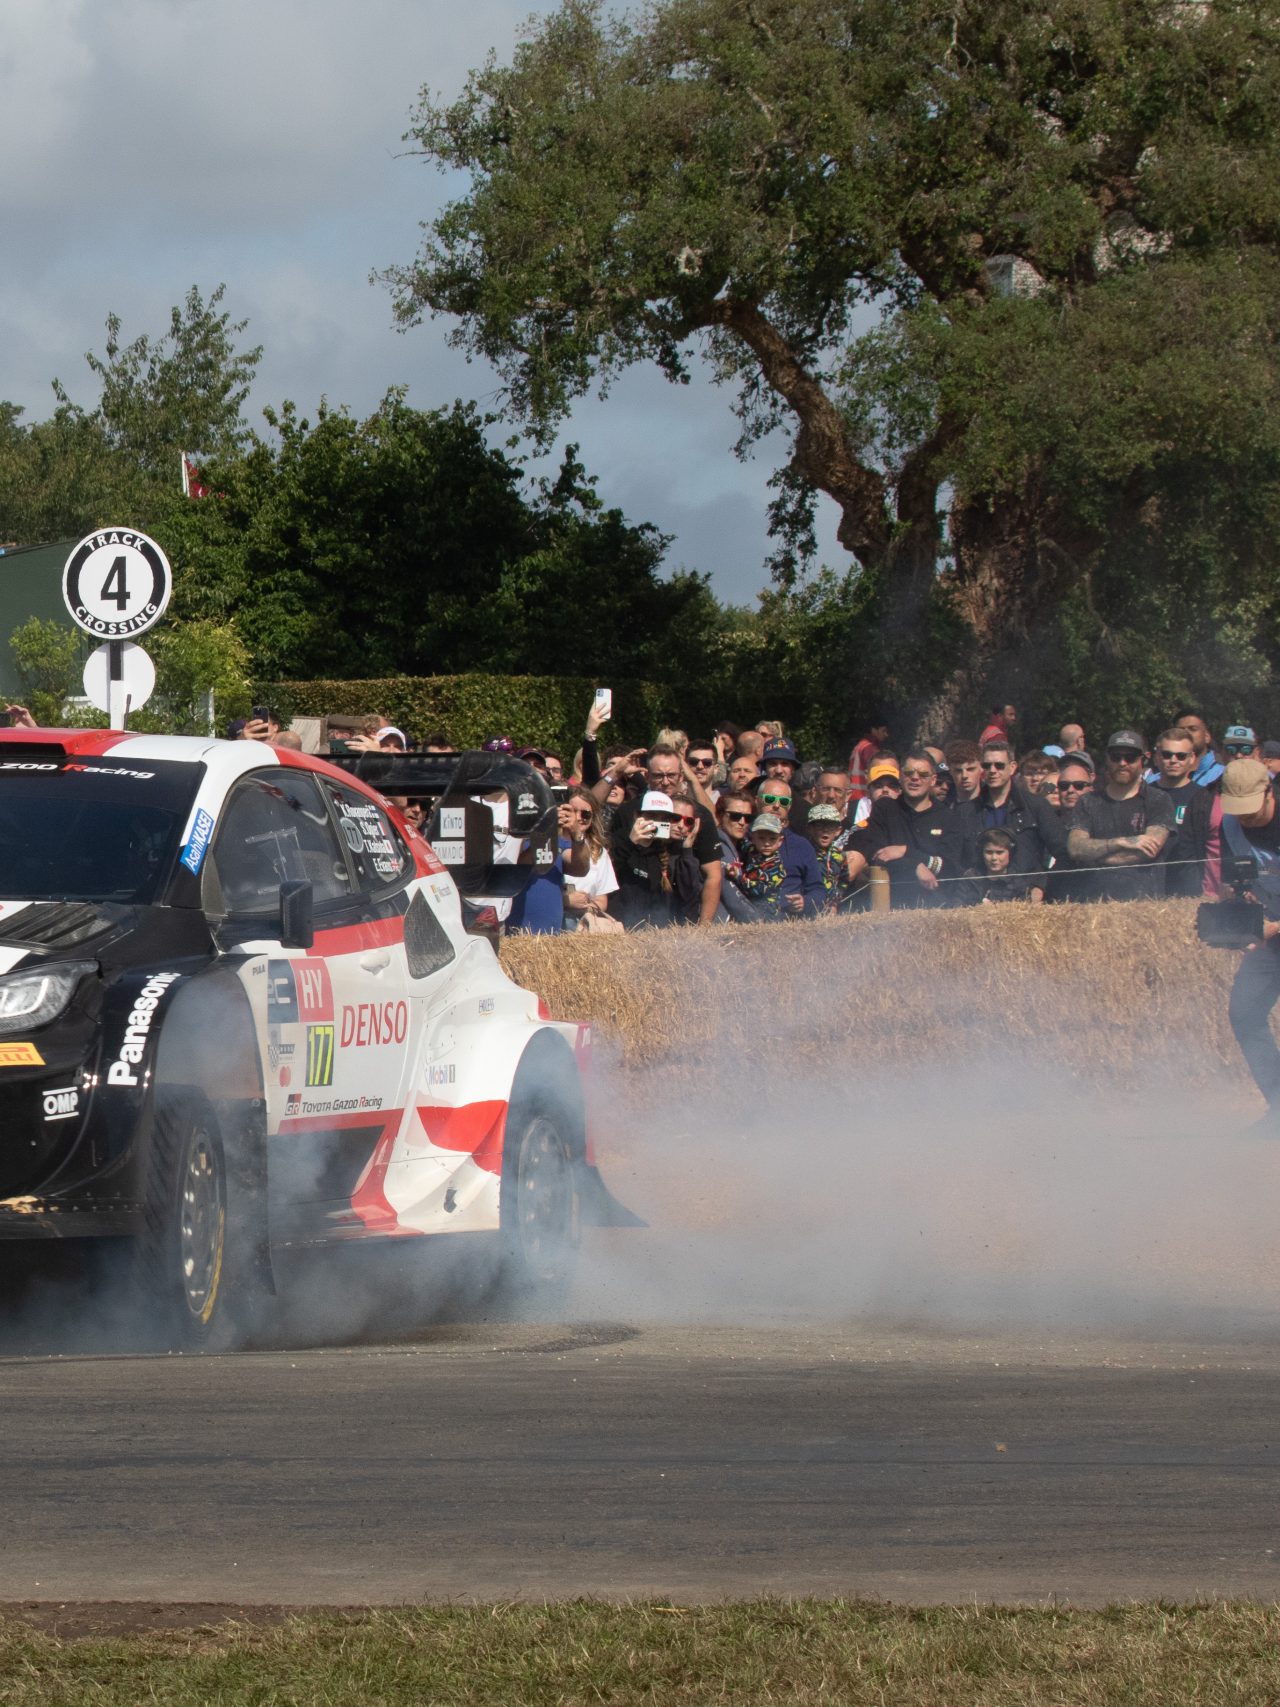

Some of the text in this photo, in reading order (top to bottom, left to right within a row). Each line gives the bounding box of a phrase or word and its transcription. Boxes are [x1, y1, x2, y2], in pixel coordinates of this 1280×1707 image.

[85, 532, 146, 552] TRACK
[100, 555, 131, 611] 4
[75, 602, 157, 635] CROSSING
[61, 763, 156, 779] Racing
[299, 968, 323, 1009] HY
[107, 972, 182, 1086] Panasonic
[340, 1000, 408, 1048] DENSO
[308, 1025, 334, 1086] 177
[428, 1064, 449, 1085] Mobil
[42, 1091, 79, 1115] OMP
[302, 1101, 332, 1114] TOYOTA
[332, 1098, 359, 1111] GAZOO
[359, 1096, 383, 1110] Racing
